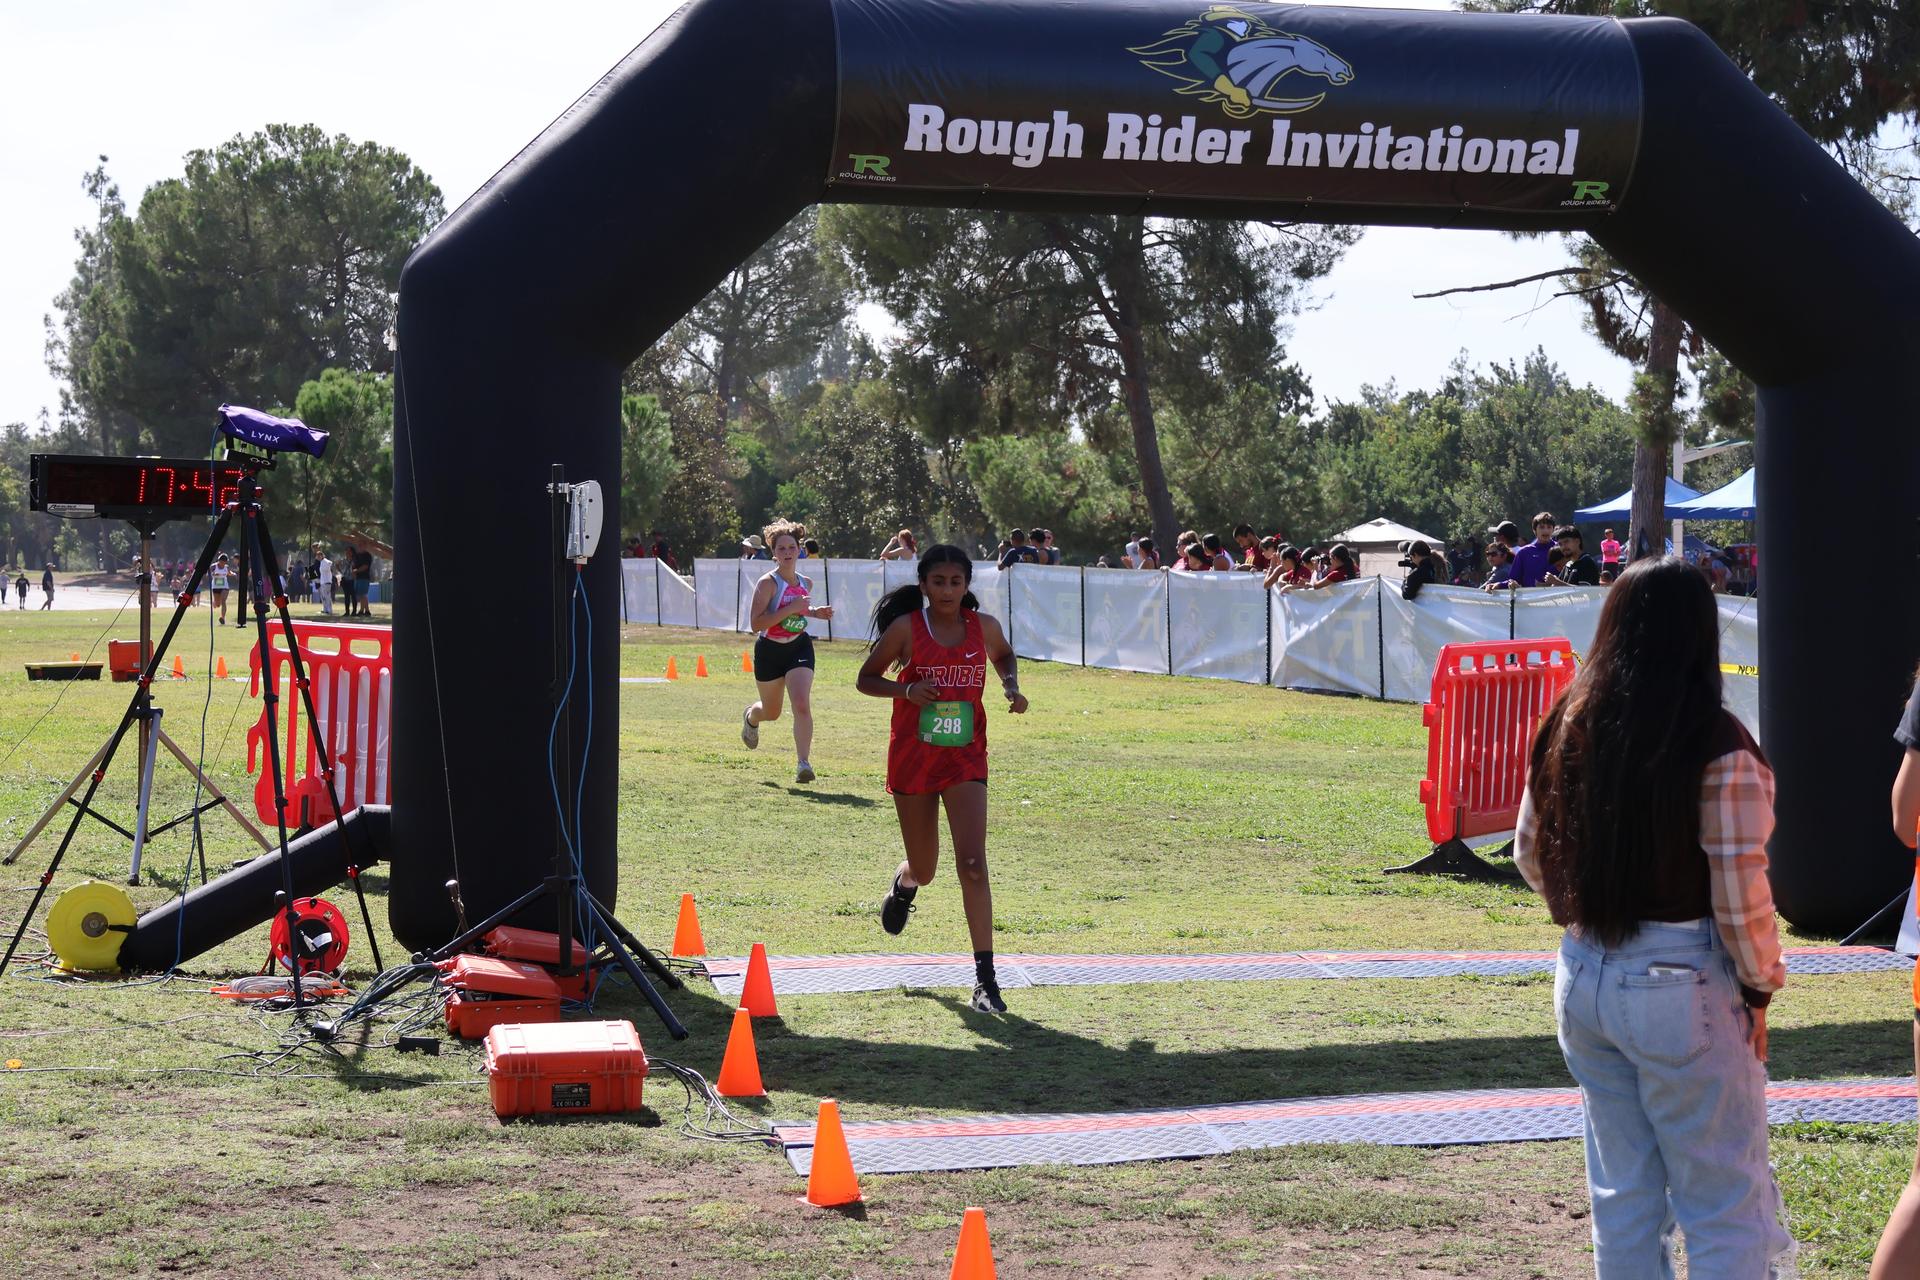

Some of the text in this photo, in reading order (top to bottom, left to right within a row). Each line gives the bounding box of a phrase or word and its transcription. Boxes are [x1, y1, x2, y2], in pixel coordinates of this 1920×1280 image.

[903, 103, 1580, 176] Rough Rider Invitational
[839, 171, 897, 183] ROUGH RIDERS
[1560, 199, 1585, 207] ROUGH
[251, 430, 280, 444] LYNX
[915, 664, 986, 688] TRIBE
[932, 717, 962, 735] 298
